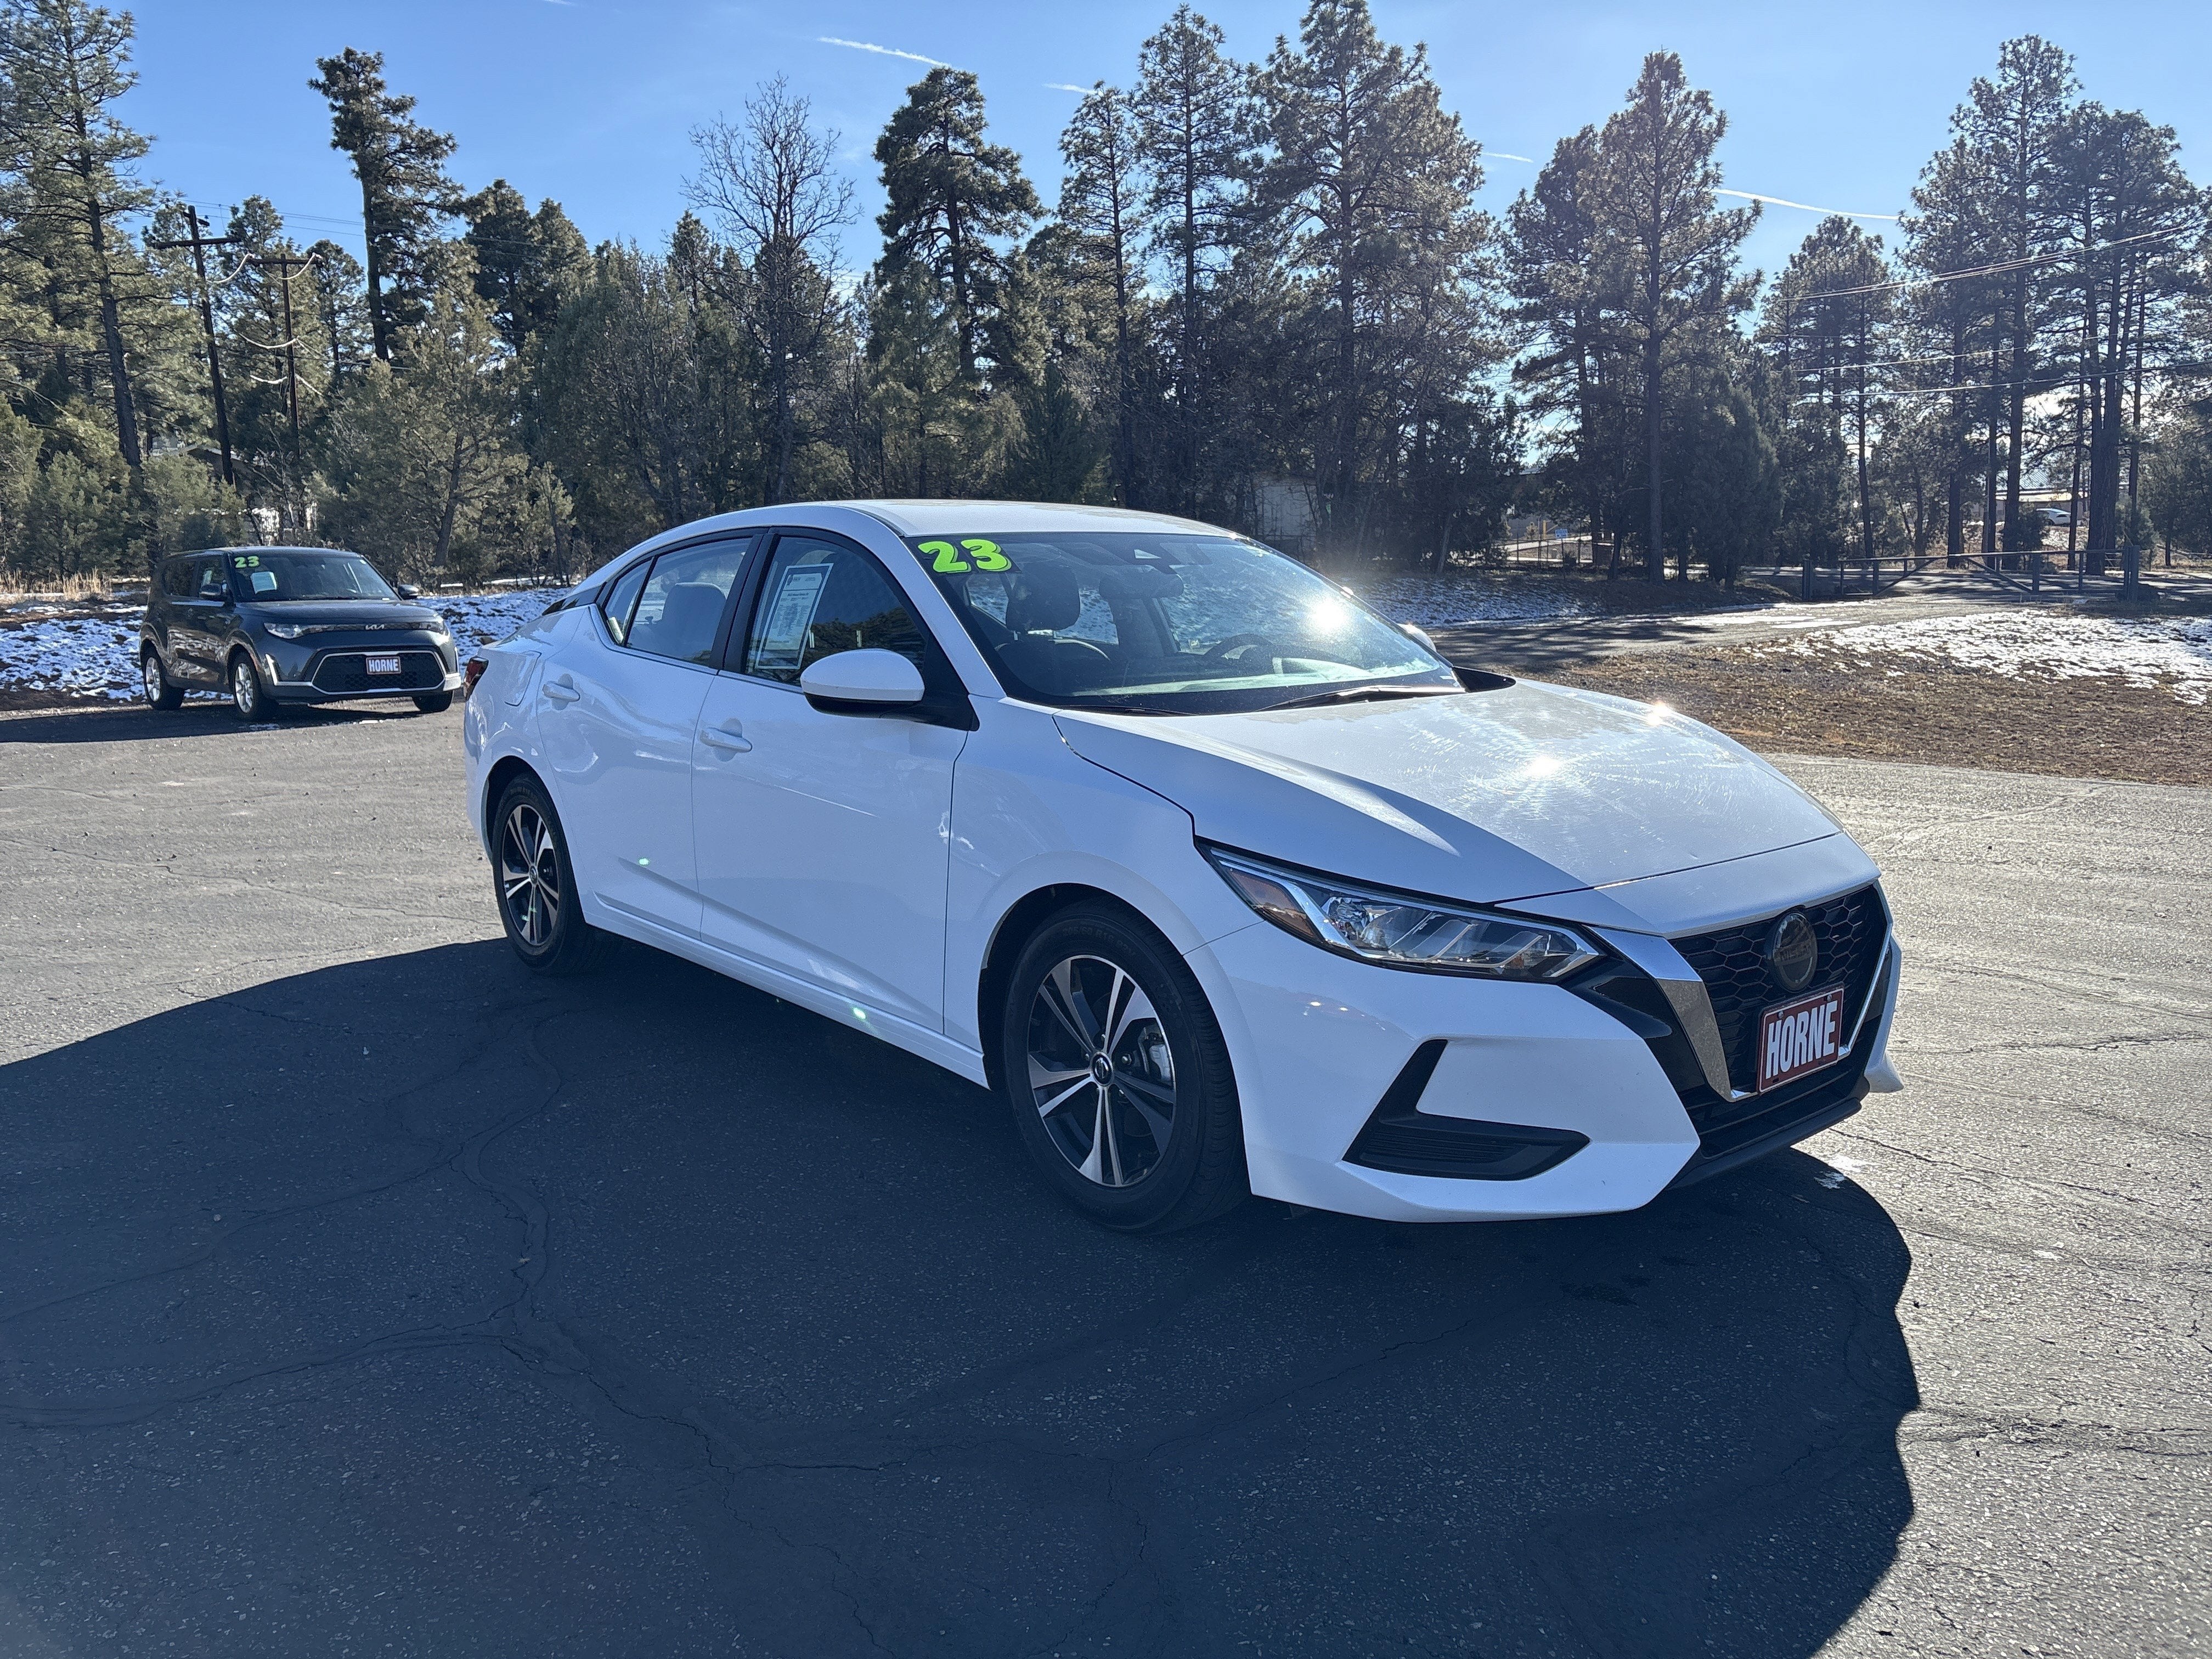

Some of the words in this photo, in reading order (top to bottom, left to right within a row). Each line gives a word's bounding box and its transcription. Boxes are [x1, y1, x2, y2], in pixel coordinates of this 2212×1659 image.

[234, 556, 259, 568] 23
[918, 539, 1012, 574] 23
[368, 659, 399, 672] HORNE
[1765, 1000, 1838, 1080] HORNE
